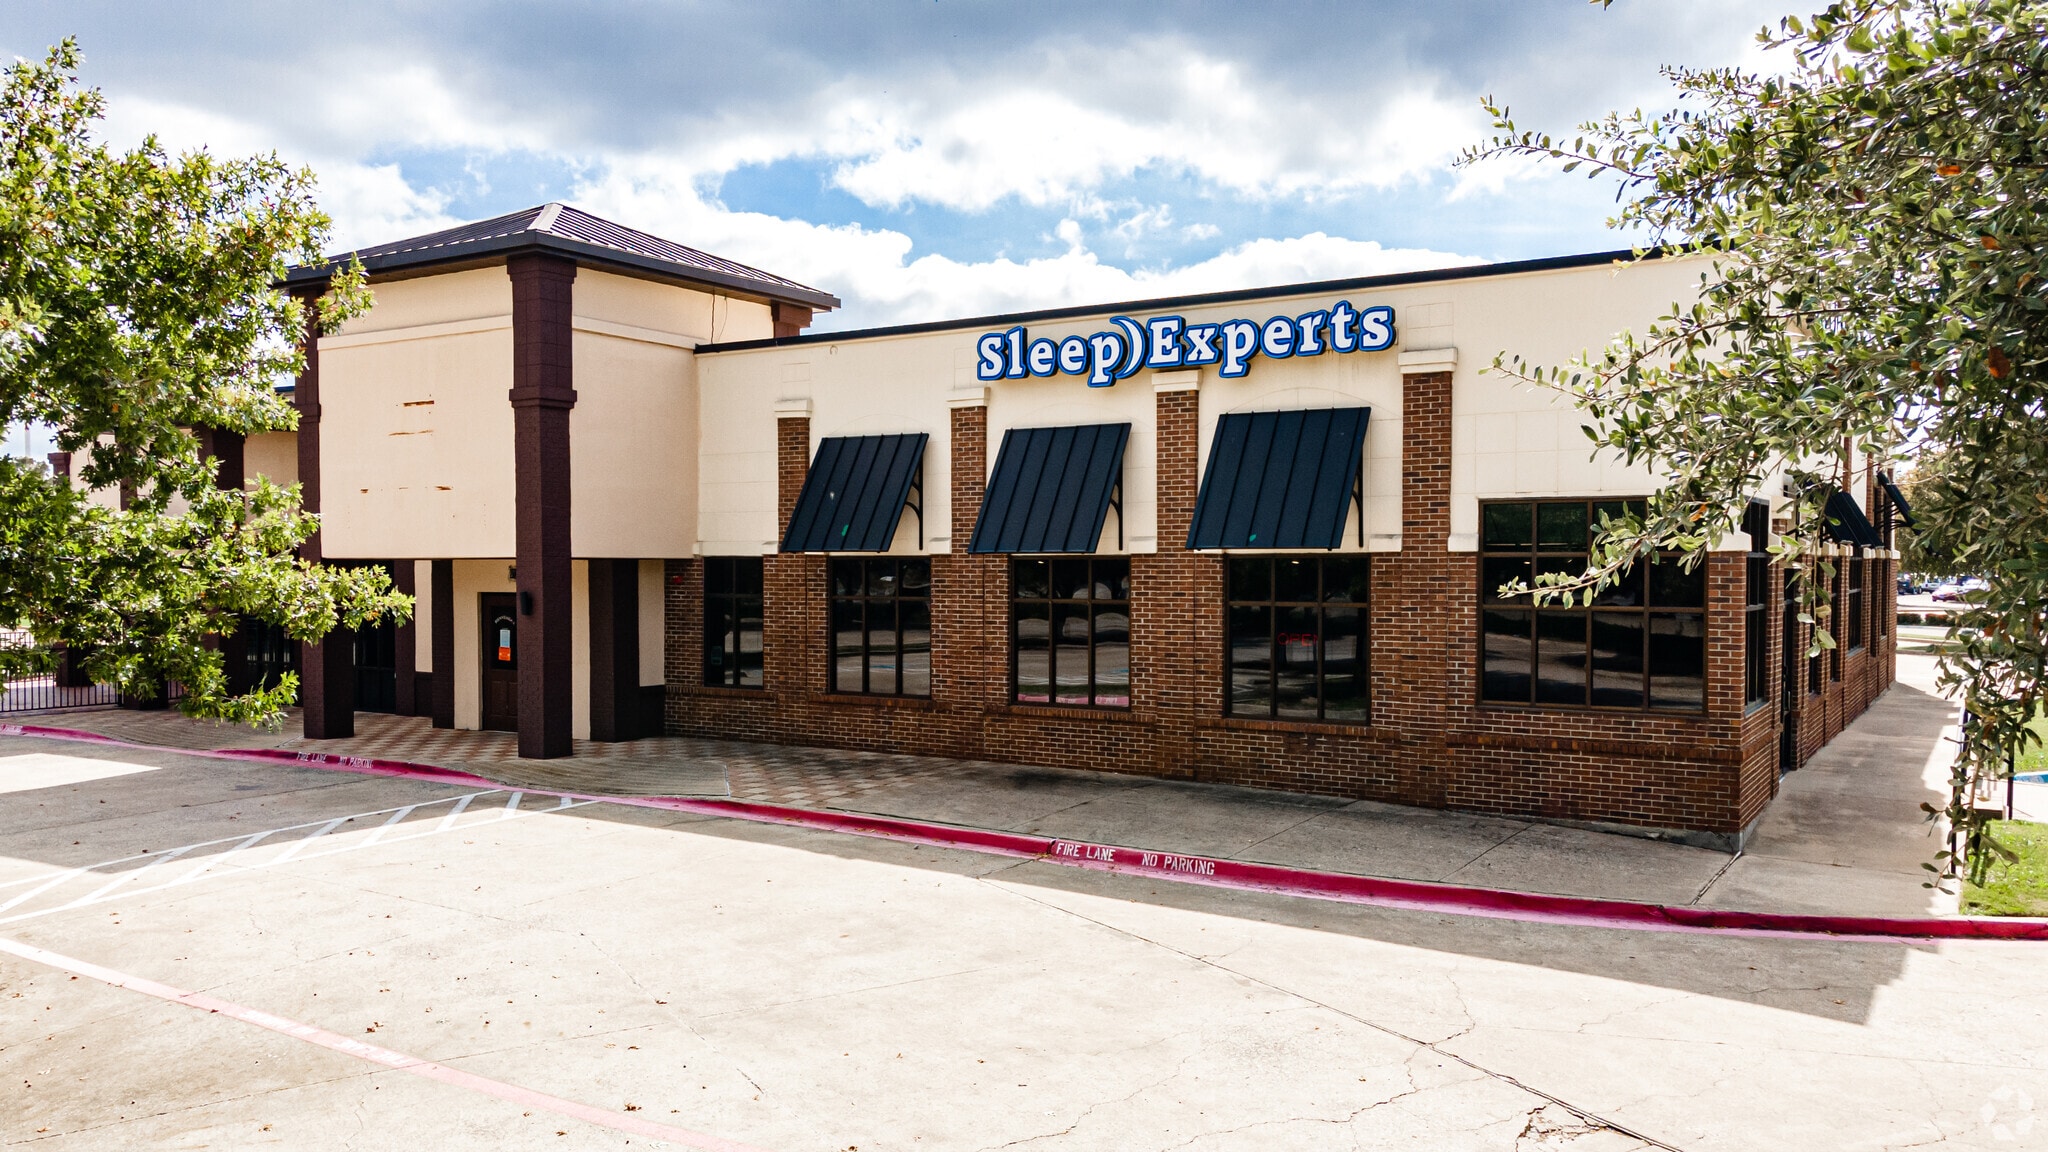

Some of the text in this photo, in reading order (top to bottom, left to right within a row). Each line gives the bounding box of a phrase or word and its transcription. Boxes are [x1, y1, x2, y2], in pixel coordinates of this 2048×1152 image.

[977, 300, 1396, 388] Sleep Experts
[1056, 842, 1215, 876] FIRE LANE NO PARKING
